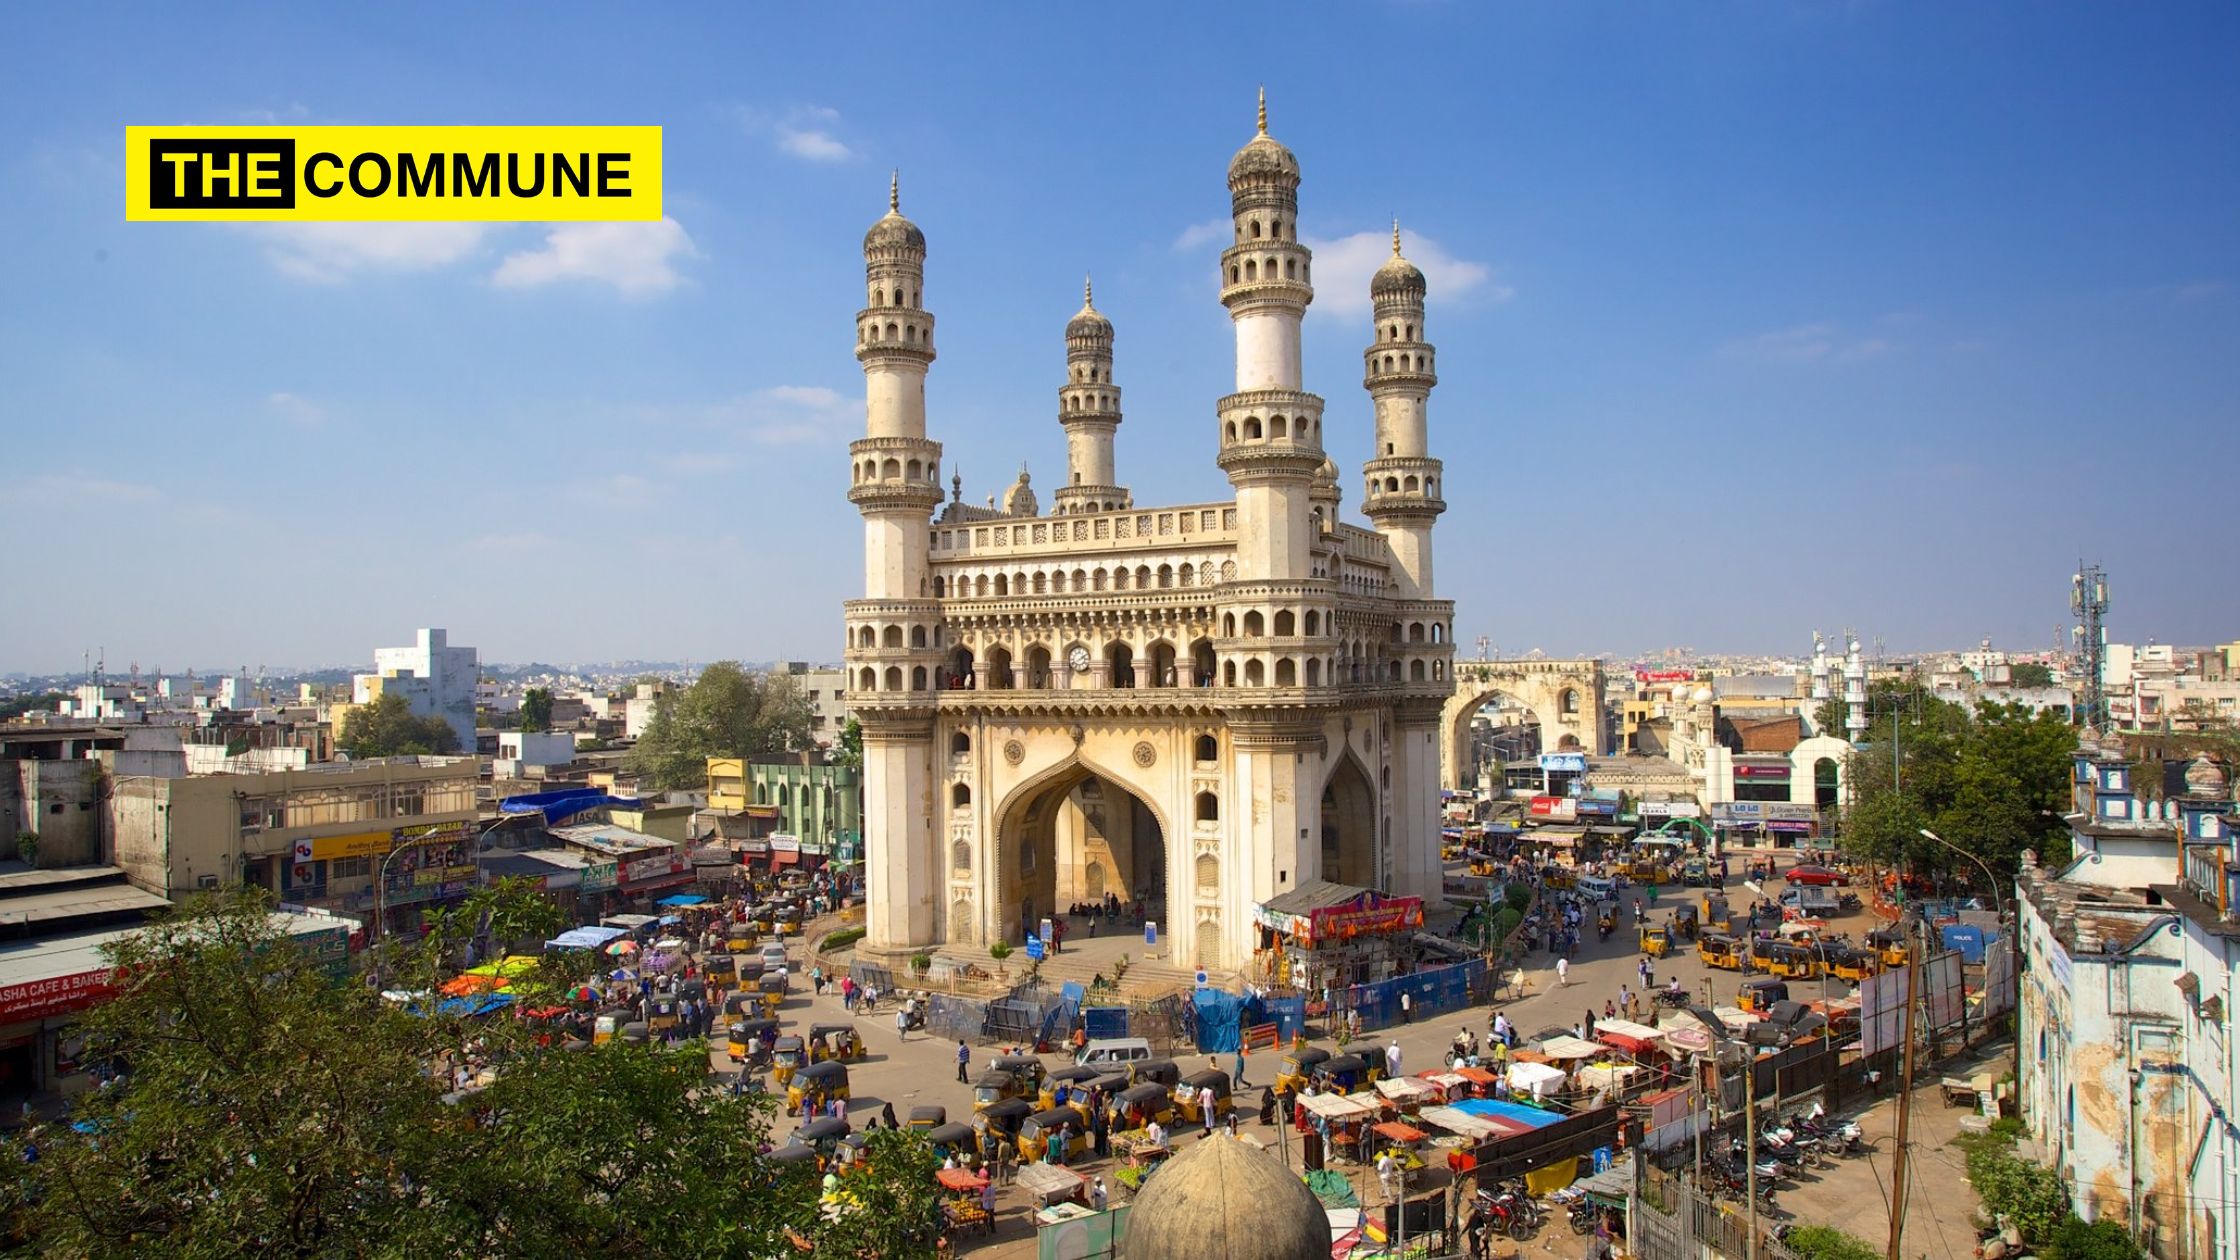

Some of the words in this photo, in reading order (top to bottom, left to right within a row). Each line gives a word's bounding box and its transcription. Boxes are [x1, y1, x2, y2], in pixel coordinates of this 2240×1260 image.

[30, 979, 59, 996] CAFE
[62, 978, 69, 990] &
[72, 973, 110, 988] BAKER
